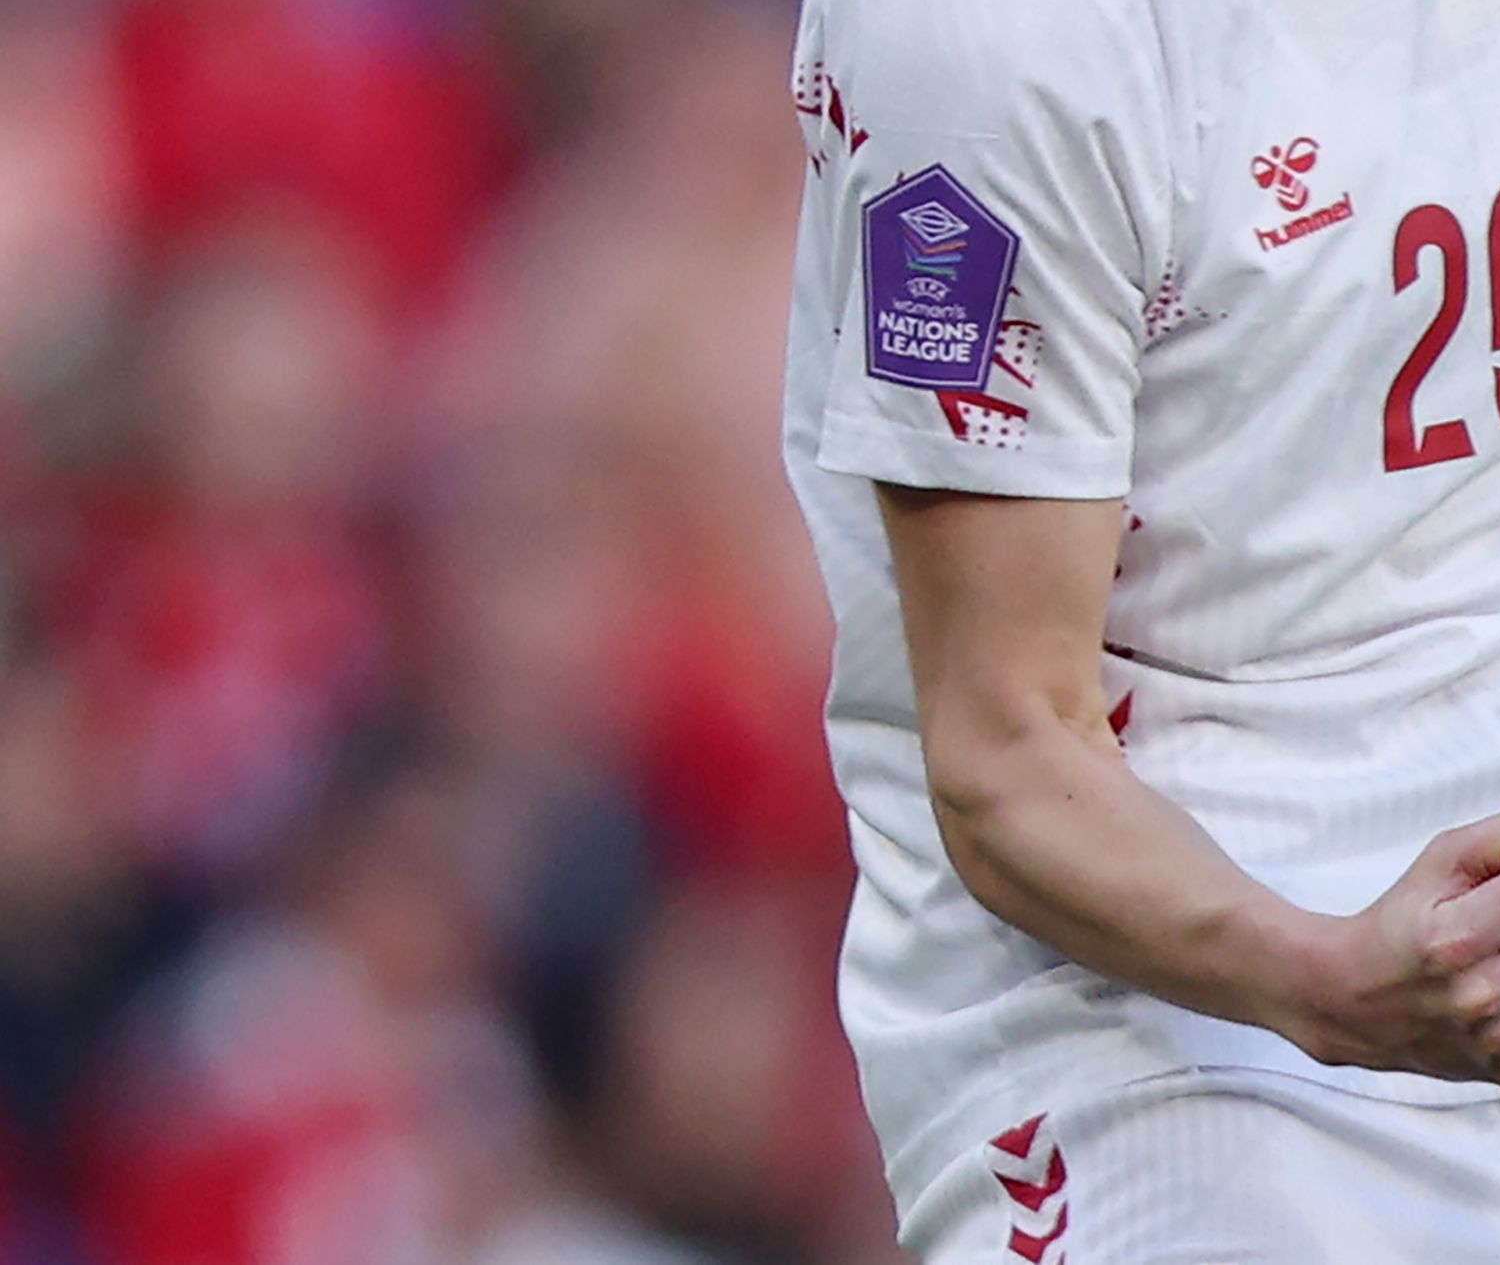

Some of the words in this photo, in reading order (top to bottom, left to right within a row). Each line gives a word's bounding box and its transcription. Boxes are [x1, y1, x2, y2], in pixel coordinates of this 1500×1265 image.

[1253, 191, 1354, 252] hummel
[878, 311, 979, 342] NATIONS
[882, 332, 971, 363] LEAGUE
